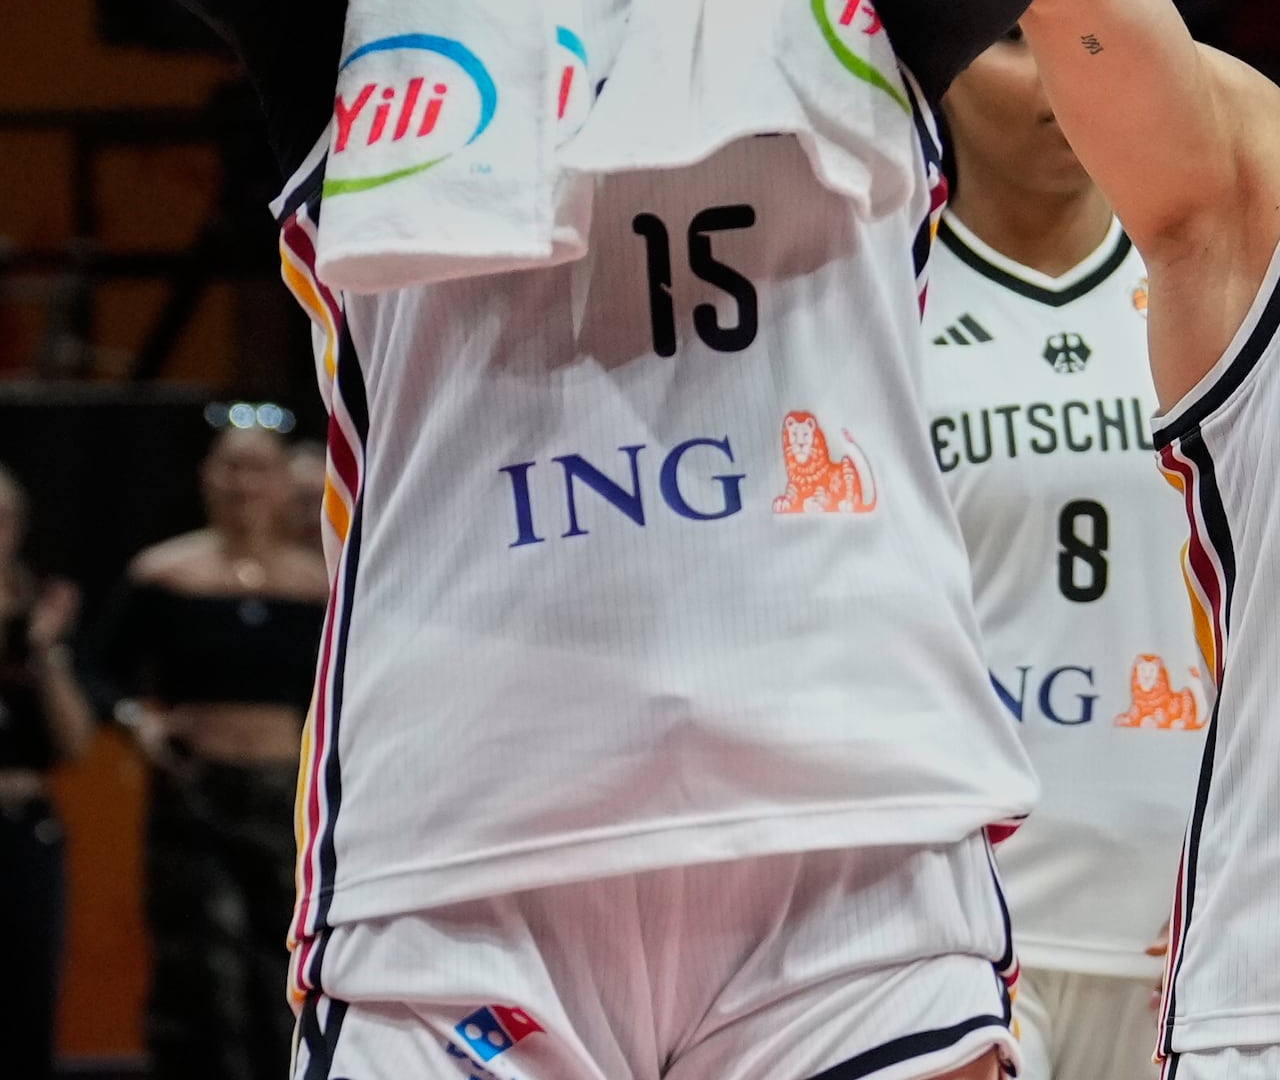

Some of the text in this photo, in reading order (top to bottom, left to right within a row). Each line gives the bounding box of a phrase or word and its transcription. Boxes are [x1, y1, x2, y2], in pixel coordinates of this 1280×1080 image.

[333, 77, 448, 154] Yili
[631, 203, 758, 358] 15
[929, 397, 1155, 473] EUTSCHL
[498, 436, 747, 549] ING
[1058, 498, 1109, 603] 8
[988, 665, 1099, 726] NG
